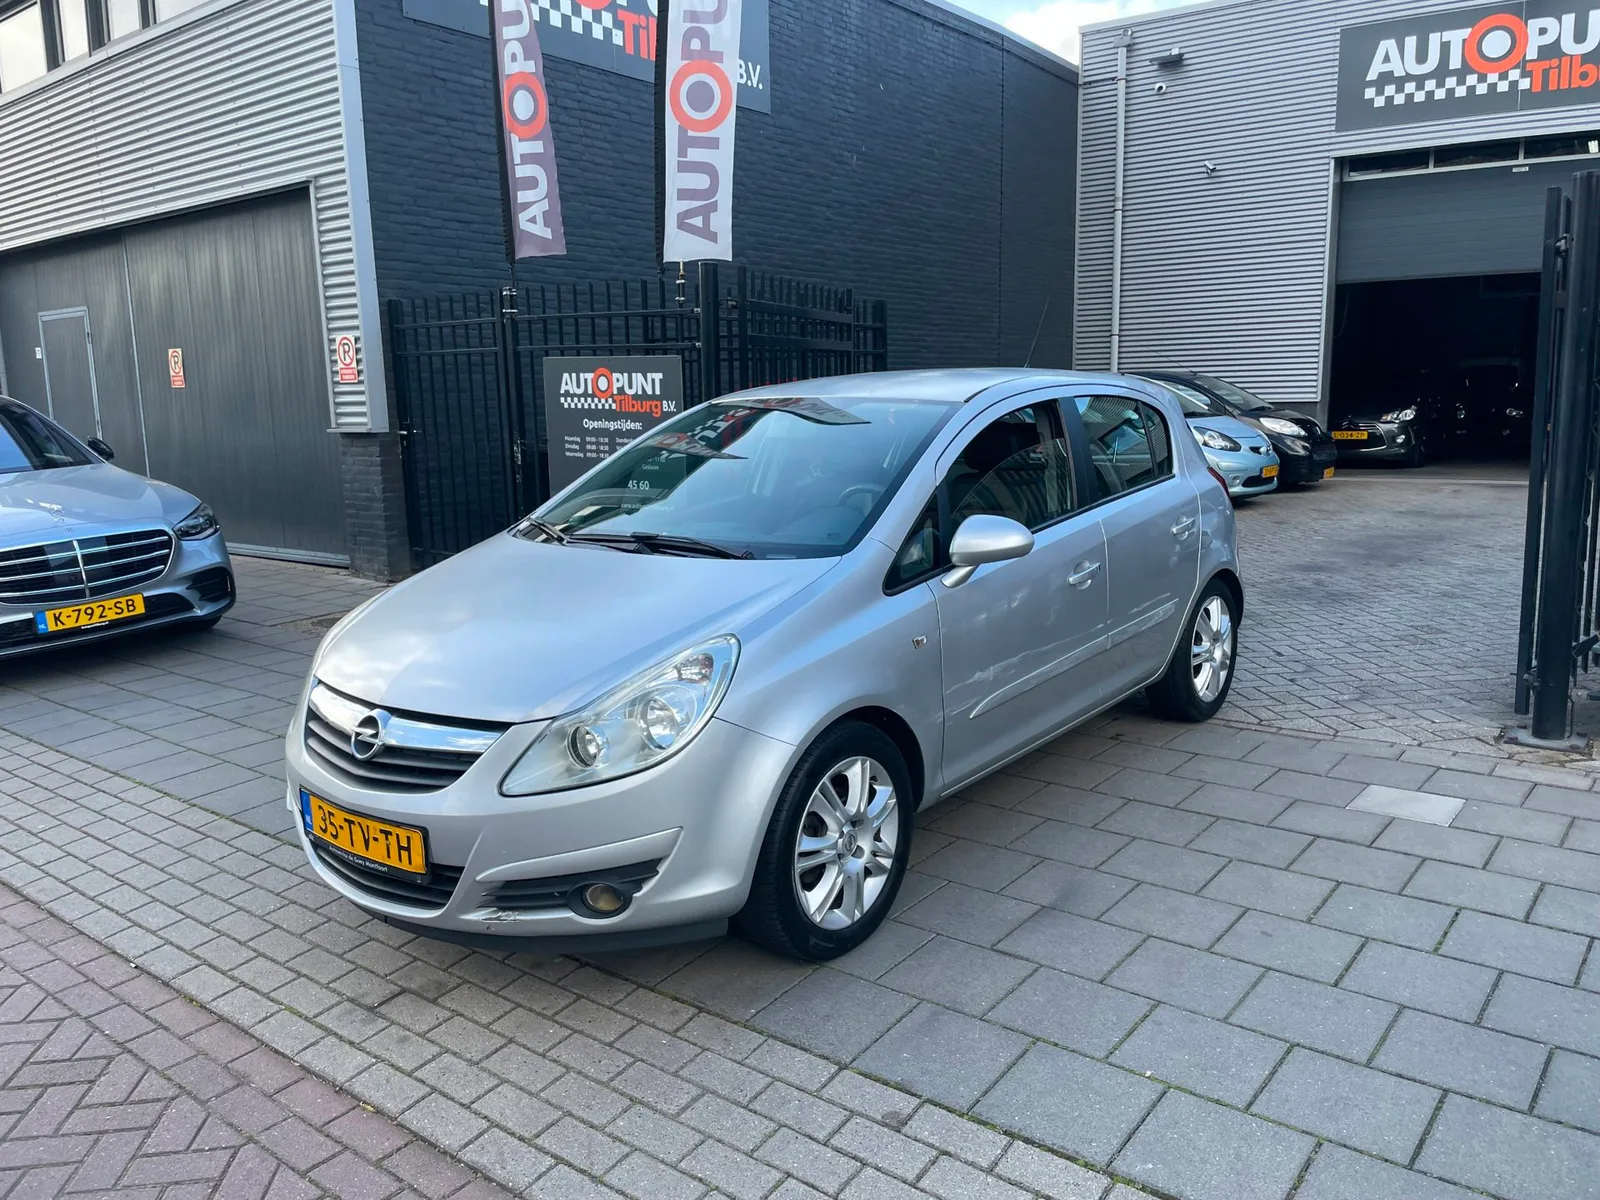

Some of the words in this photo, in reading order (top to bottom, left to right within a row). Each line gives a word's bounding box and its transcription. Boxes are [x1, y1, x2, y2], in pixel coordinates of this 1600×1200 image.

[1526, 55, 1600, 93] Tilb
[560, 367, 663, 399] AUTOPUNT
[613, 395, 662, 417] Tilburg
[662, 400, 677, 412] B.V.
[583, 419, 643, 432] Openingstijden:
[628, 480, 637, 490] 45
[639, 481, 650, 491] 60
[53, 599, 136, 627] K-792-SB
[318, 805, 413, 865] 35-TV-TH
